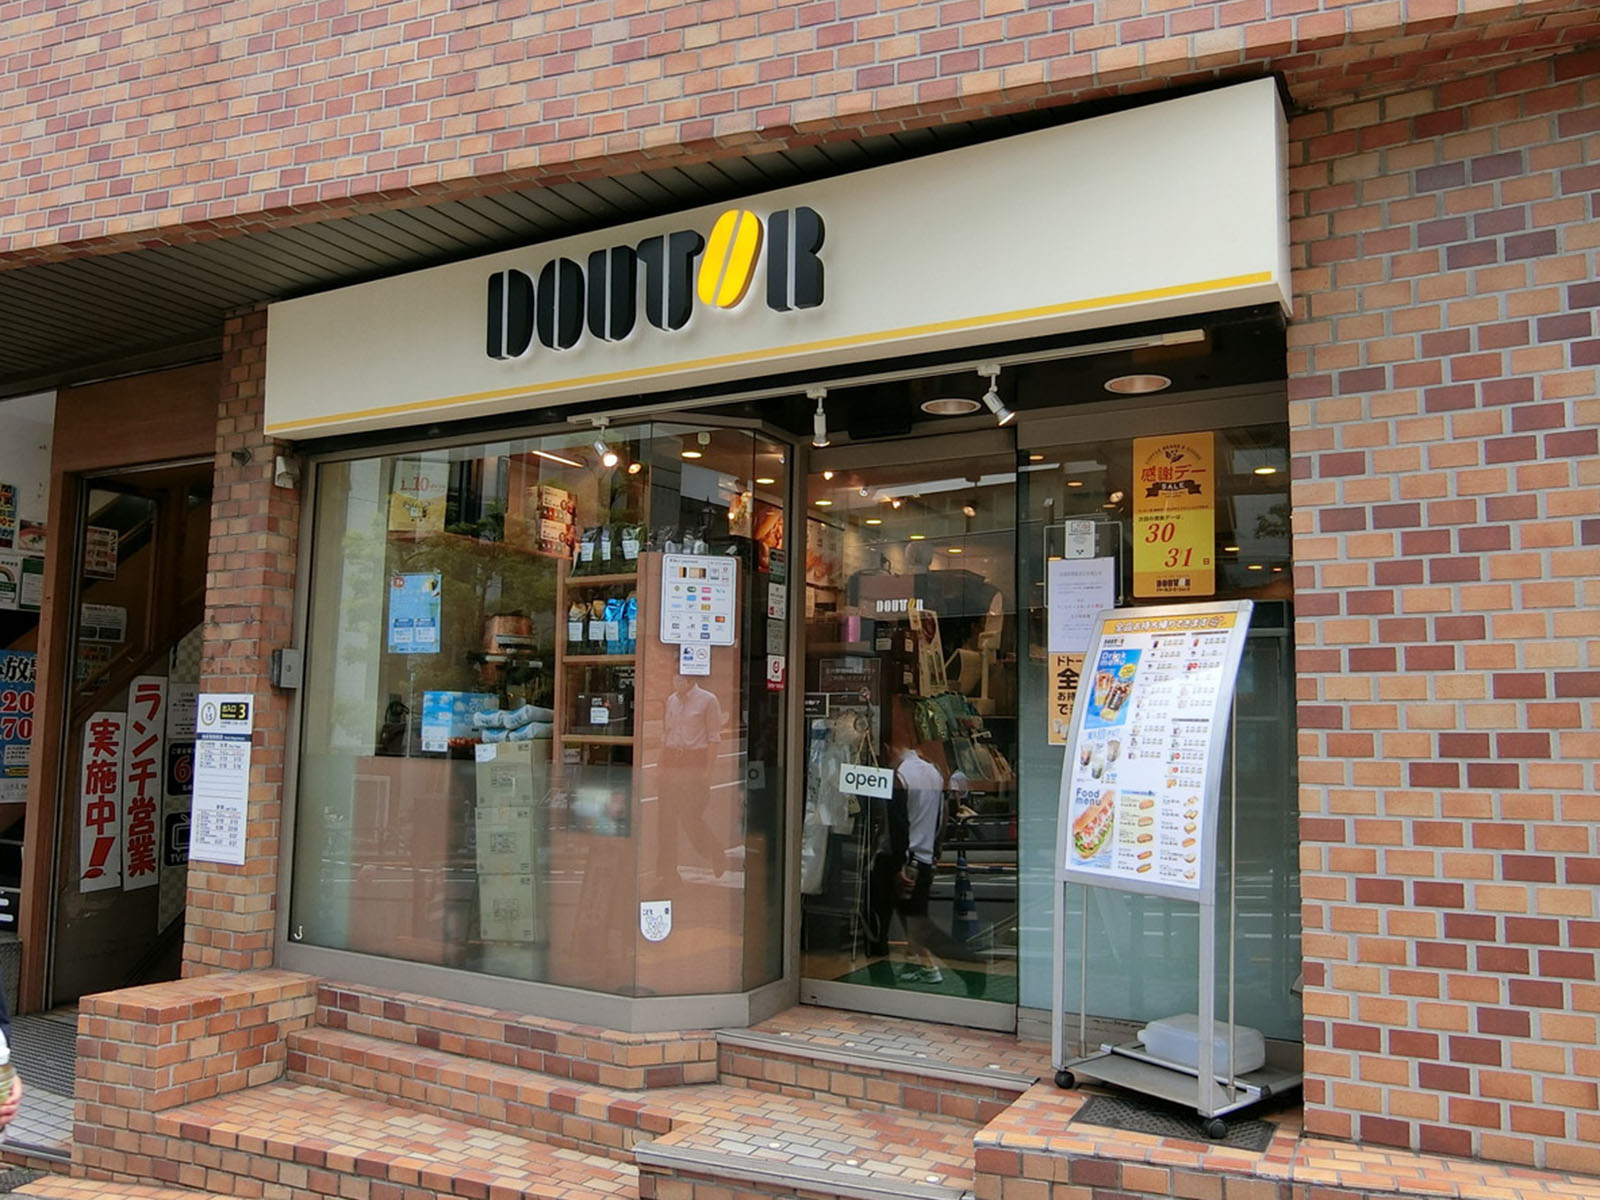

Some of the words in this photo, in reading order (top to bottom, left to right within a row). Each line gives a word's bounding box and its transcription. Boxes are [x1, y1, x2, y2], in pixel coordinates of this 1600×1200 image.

[486, 206, 826, 361] DOUTOR
[1141, 464, 1206, 482] 感謝デー
[1161, 482, 1185, 490] SALE
[1145, 522, 1175, 543] 30
[1164, 547, 1192, 568] 31
[239, 704, 246, 718] 3
[127, 684, 162, 878] ランチ営業
[845, 771, 888, 790] open
[1075, 797, 1102, 806] menu
[1076, 788, 1100, 798] Food
